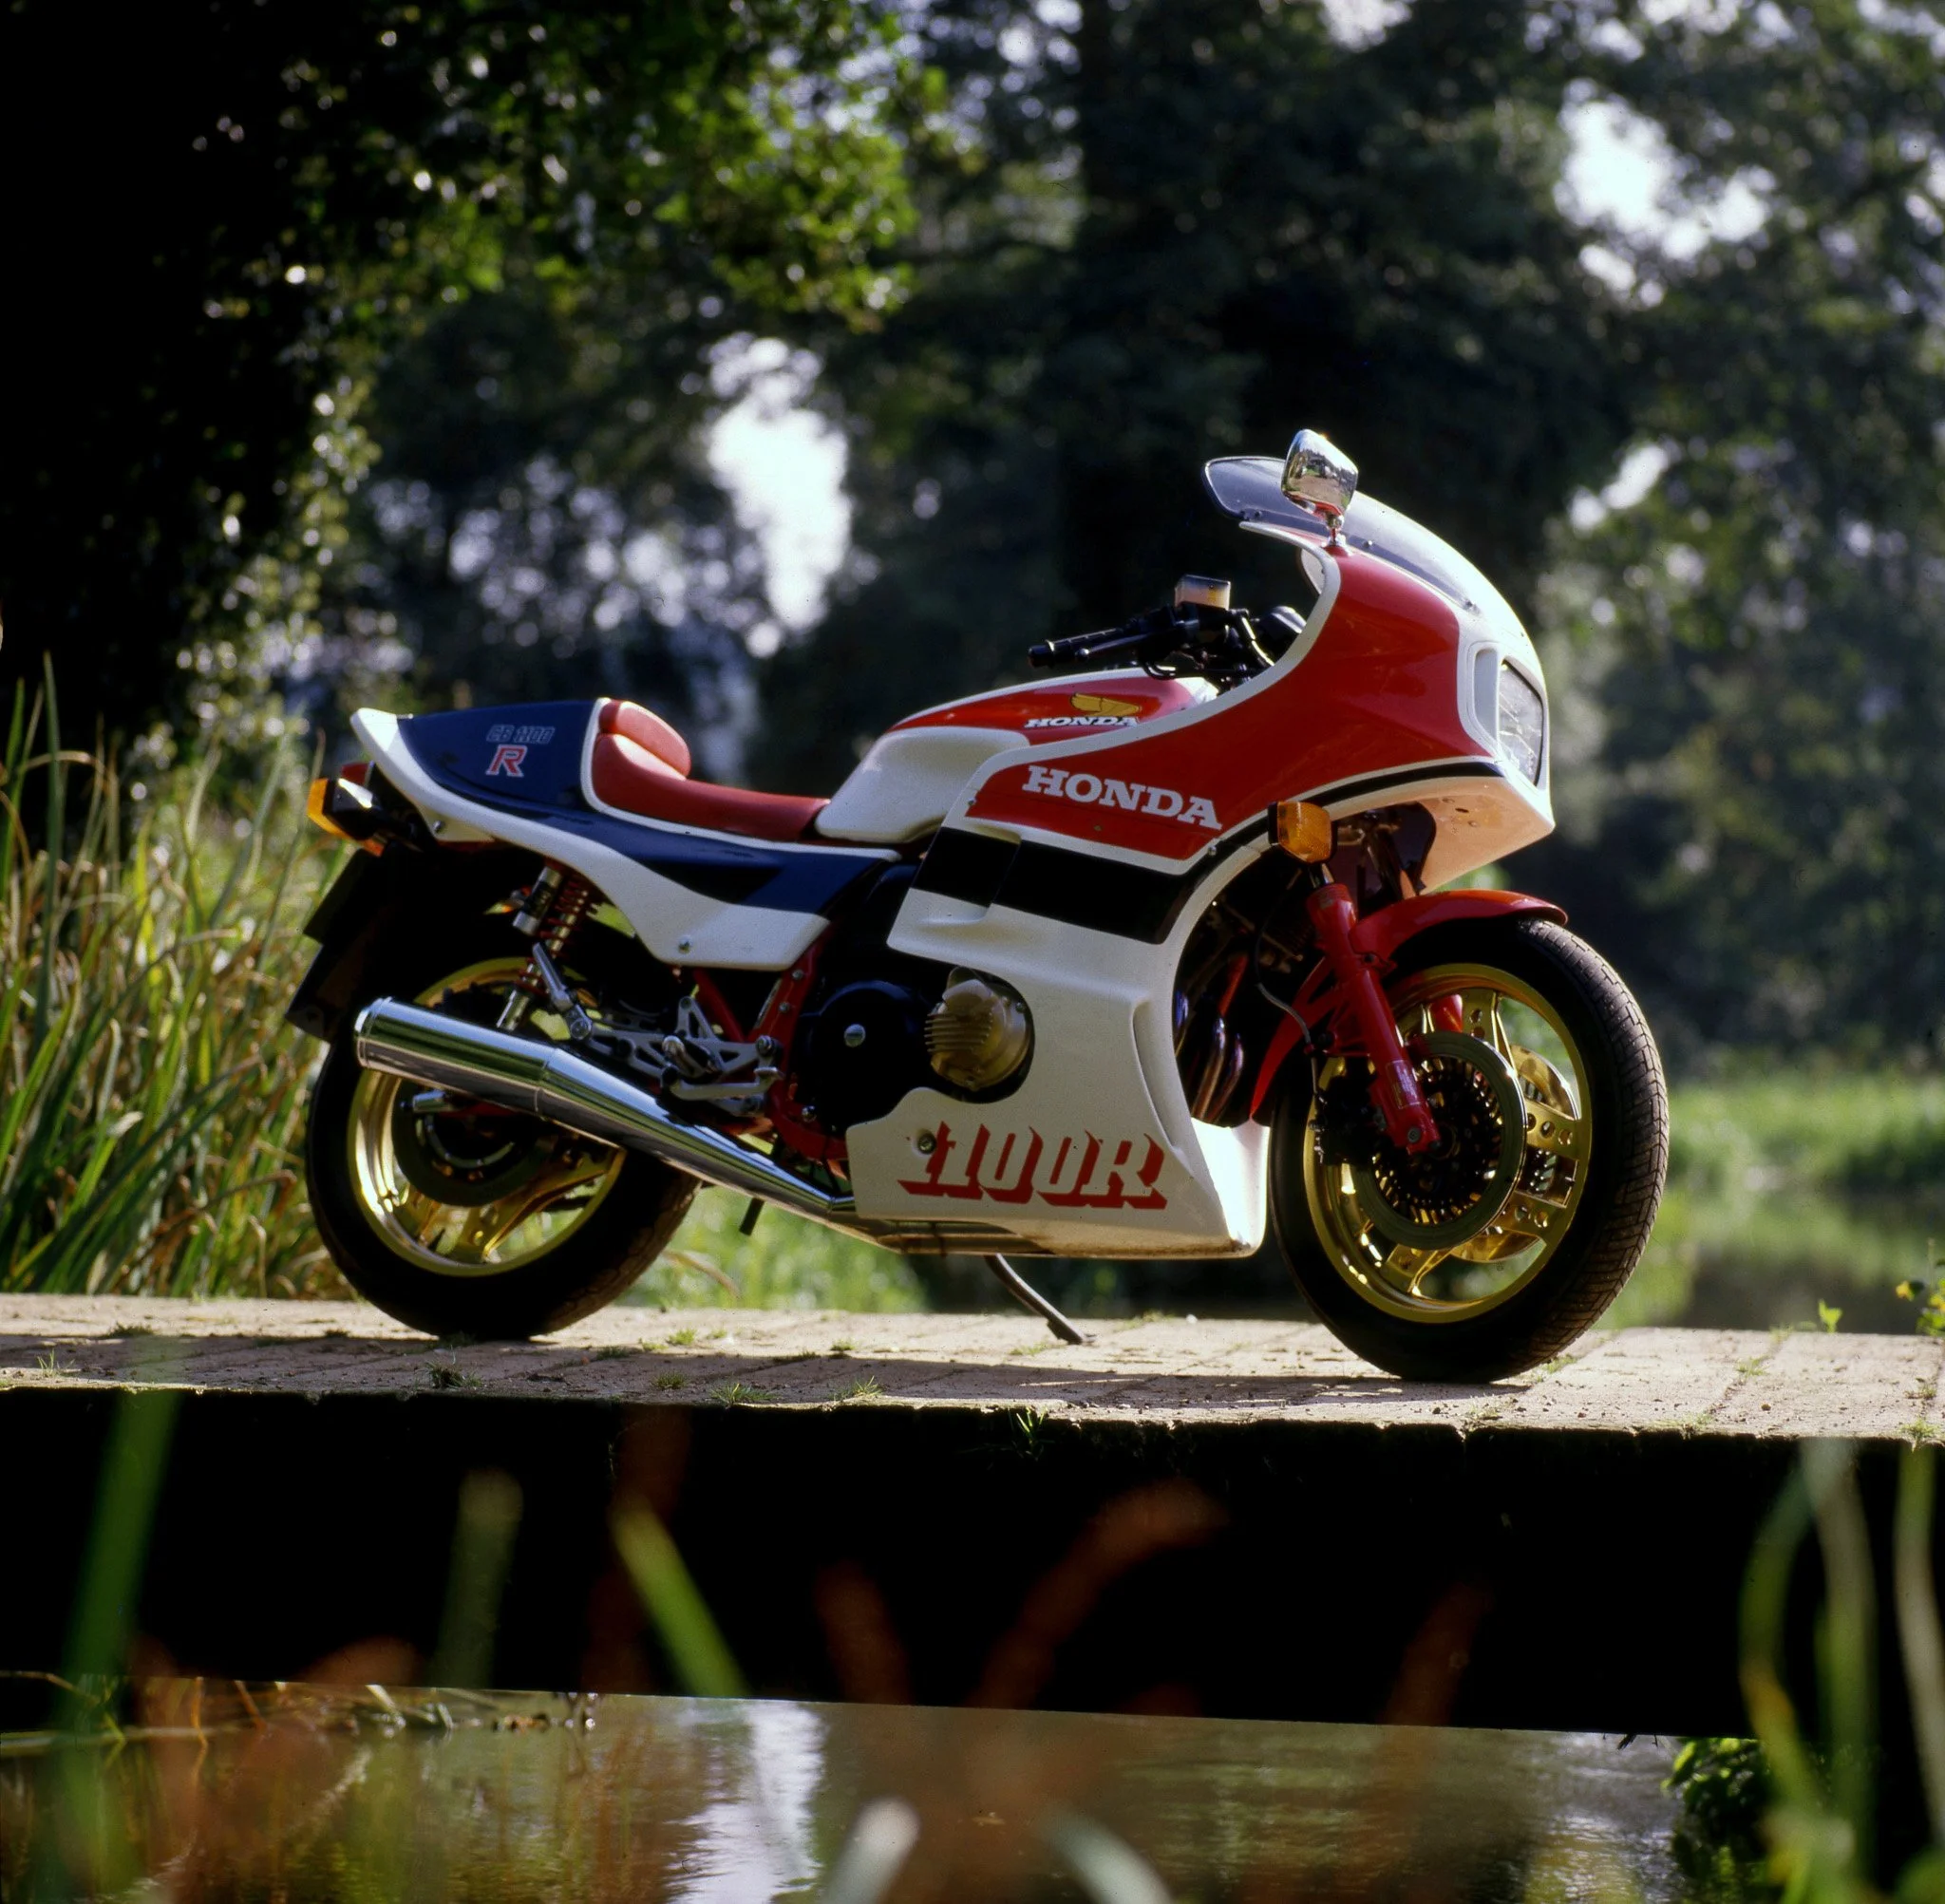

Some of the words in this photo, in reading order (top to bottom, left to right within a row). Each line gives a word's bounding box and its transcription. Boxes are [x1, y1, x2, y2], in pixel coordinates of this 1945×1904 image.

[486, 724, 515, 742] CB
[1024, 716, 1139, 728] HONDA
[484, 744, 528, 777] R
[1022, 764, 1222, 831] HONDA
[897, 1121, 1168, 1210] 1100R
